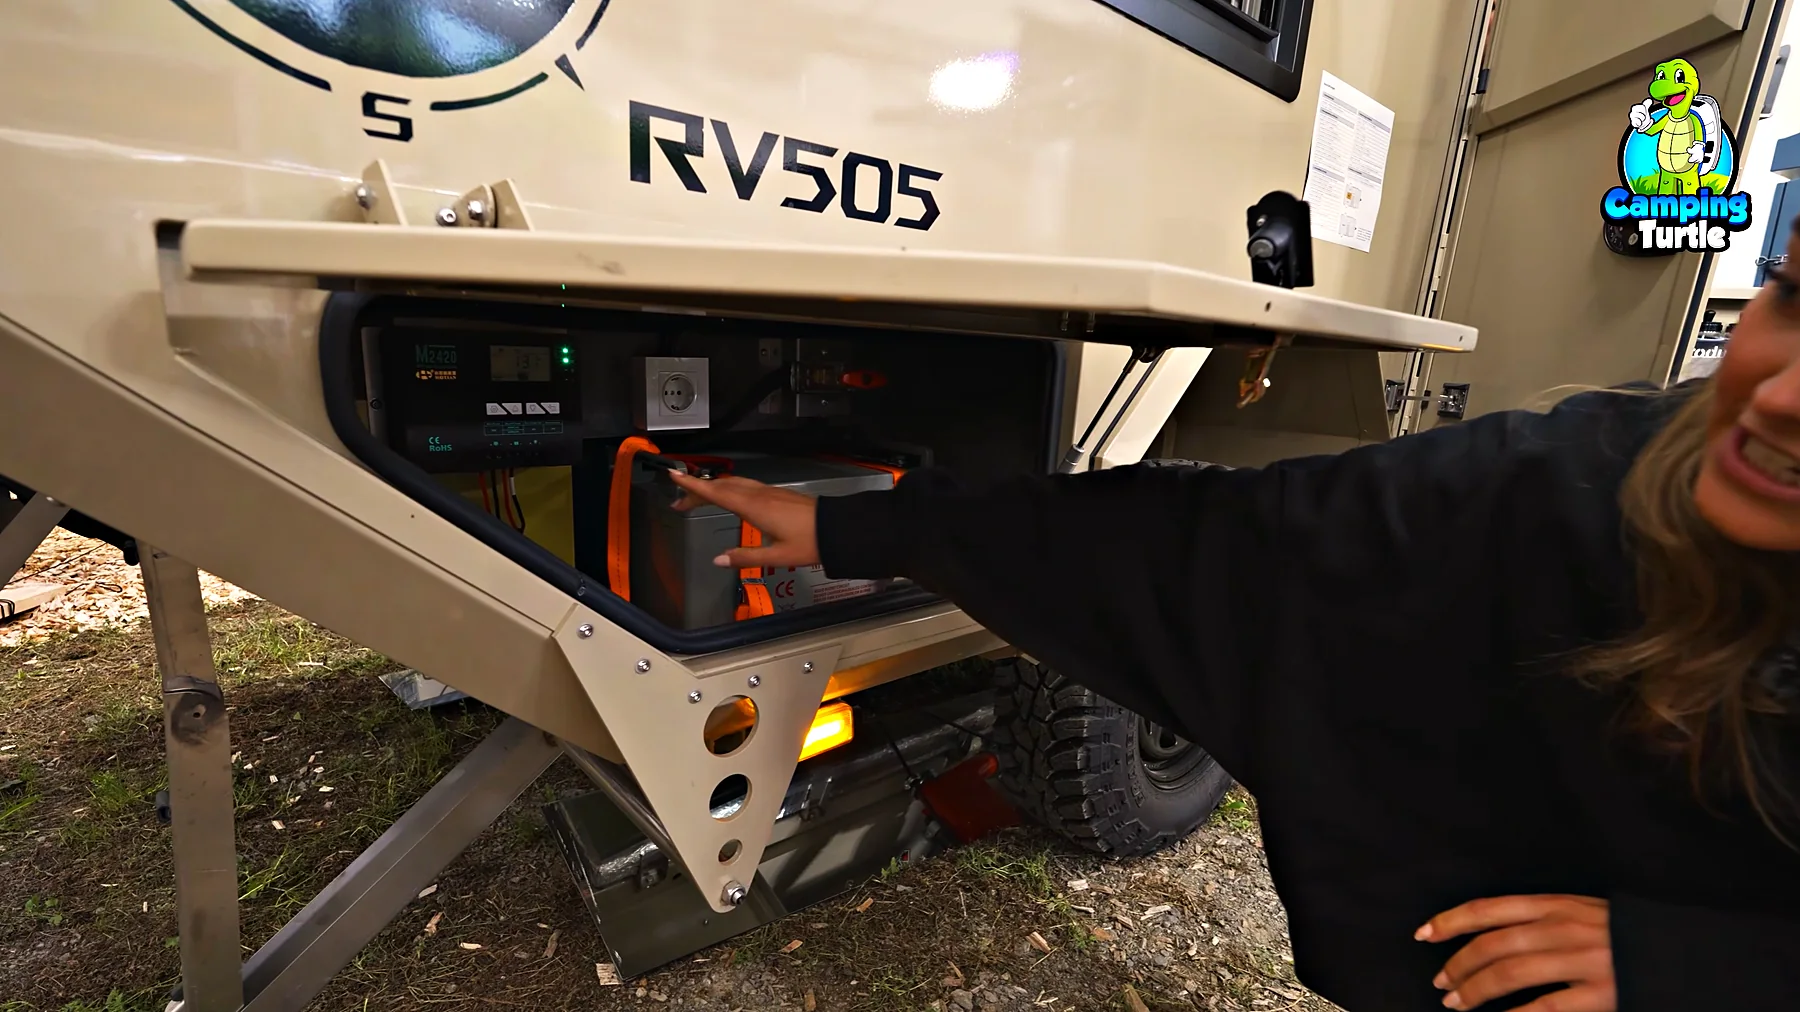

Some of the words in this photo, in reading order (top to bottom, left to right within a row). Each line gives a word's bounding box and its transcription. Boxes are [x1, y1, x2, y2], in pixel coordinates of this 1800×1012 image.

[361, 92, 413, 142] S
[629, 100, 943, 231] RV505
[415, 344, 457, 364] M2420
[428, 436, 440, 444] CE
[429, 444, 452, 452] RoHS
[775, 579, 795, 598] CE
